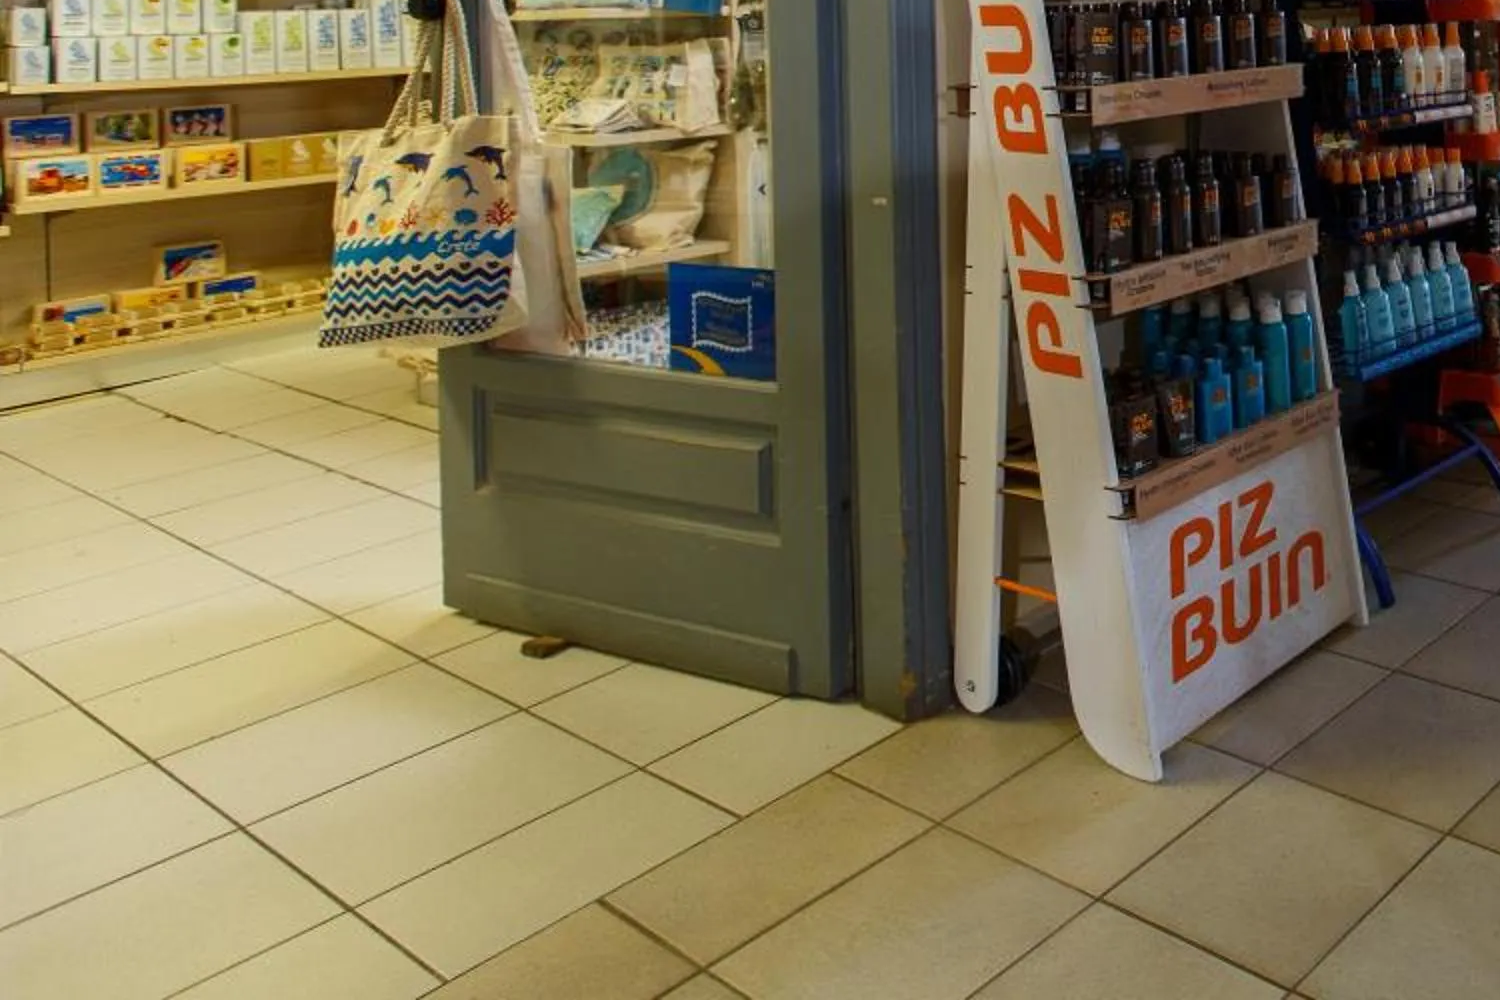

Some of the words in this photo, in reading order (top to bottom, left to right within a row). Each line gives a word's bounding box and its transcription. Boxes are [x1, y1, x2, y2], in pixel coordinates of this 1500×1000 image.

[1006, 193, 1084, 379] PIZ
[1169, 479, 1278, 600] PIZ
[1170, 530, 1326, 684] BUIN
